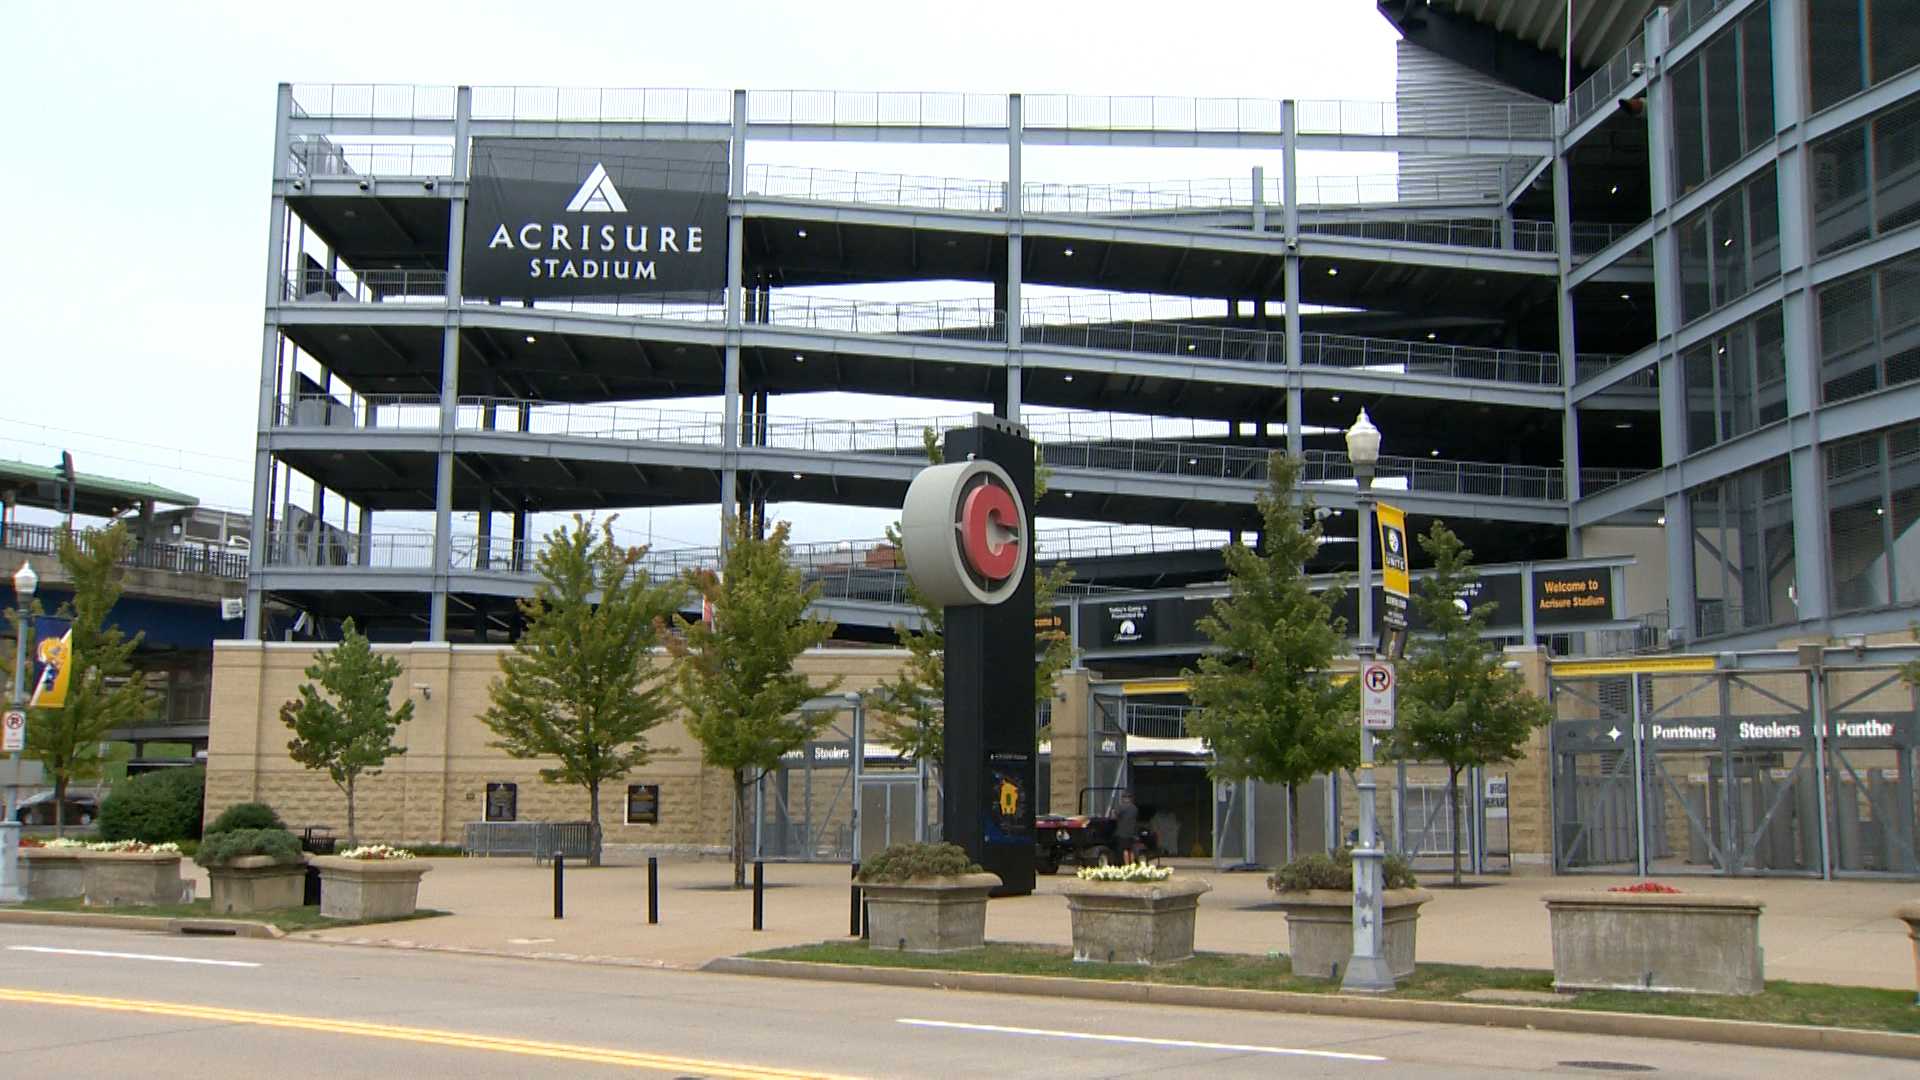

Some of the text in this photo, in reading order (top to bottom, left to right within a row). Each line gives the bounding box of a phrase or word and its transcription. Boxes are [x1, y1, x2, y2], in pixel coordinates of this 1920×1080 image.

[488, 222, 704, 253] ACRISURE
[530, 258, 657, 280] STADIUM
[1545, 579, 1599, 592] Welcome to
[1540, 596, 1605, 609] Acrisure Stadium
[1652, 725, 1716, 740] Panthers
[1739, 721, 1801, 739] Steelers
[1836, 719, 1894, 737] Panthe
[815, 746, 849, 760] Steelers
